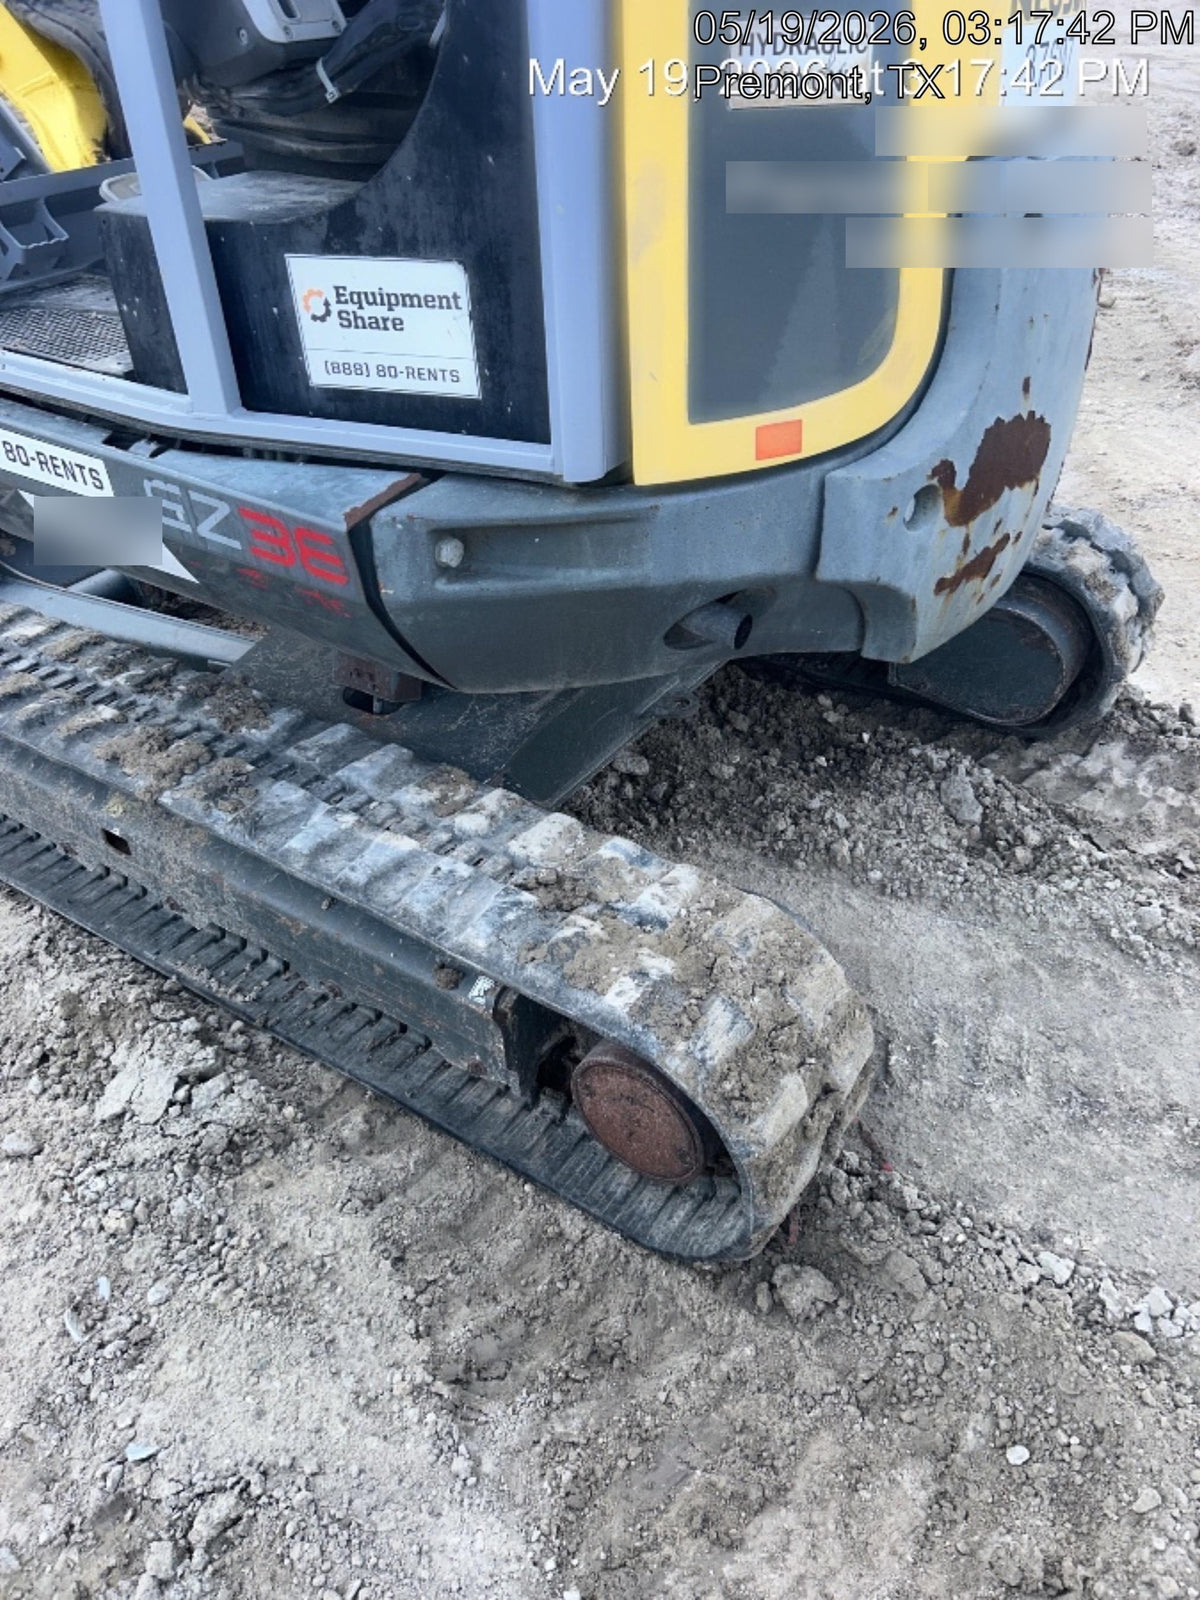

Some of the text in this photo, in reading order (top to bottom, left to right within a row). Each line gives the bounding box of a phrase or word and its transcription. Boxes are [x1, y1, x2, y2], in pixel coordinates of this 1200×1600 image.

[333, 285, 463, 312] Equipment
[337, 309, 405, 332] Share
[324, 360, 461, 383] (888) 80-RENTS
[2, 440, 105, 491] 80-RENTS
